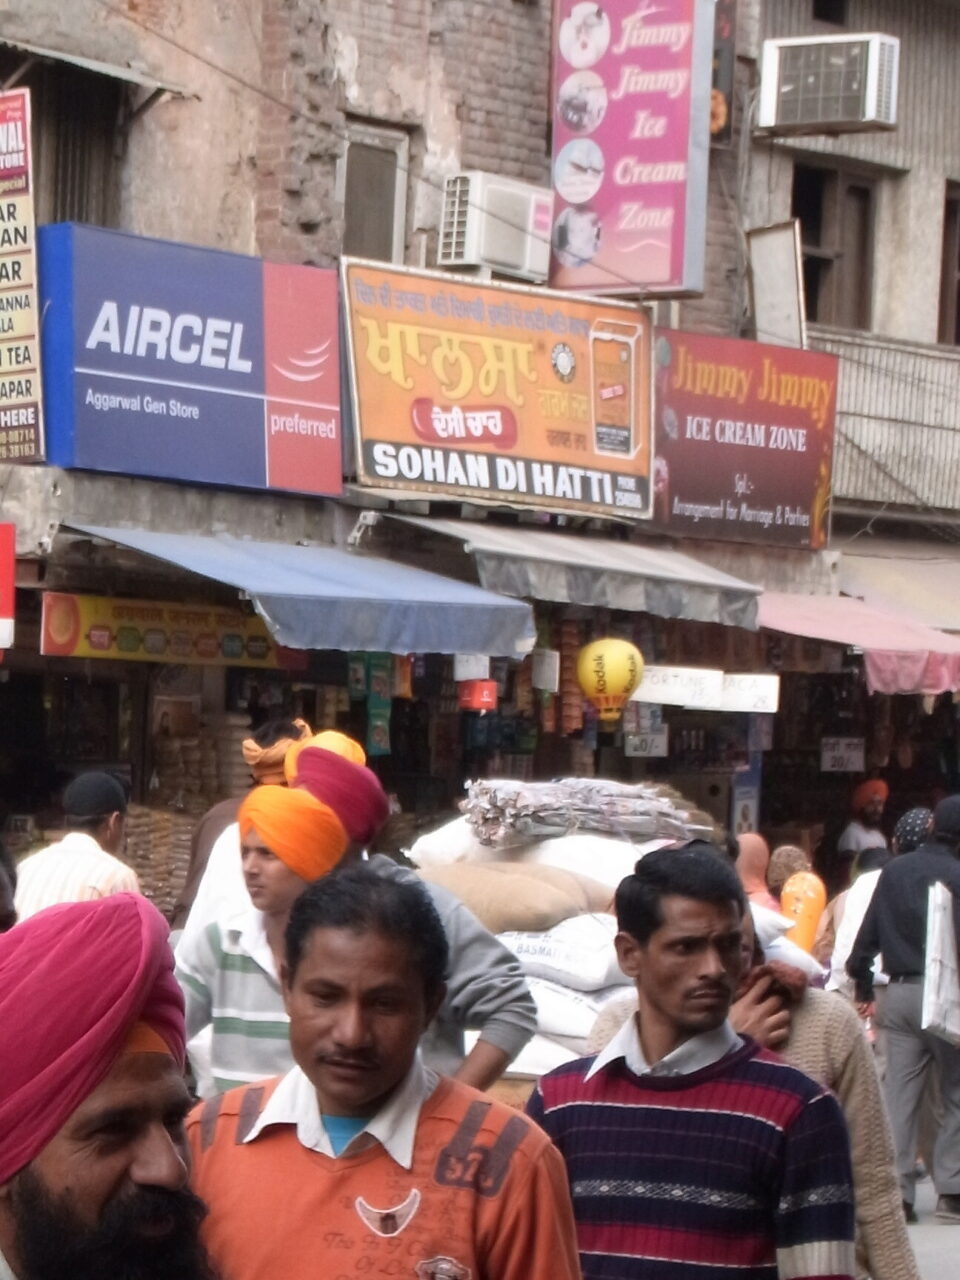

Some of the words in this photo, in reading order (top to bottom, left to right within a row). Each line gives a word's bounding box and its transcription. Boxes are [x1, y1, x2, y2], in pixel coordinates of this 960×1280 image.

[612, 18, 692, 54] Jimmy
[611, 64, 689, 99] Jimmy
[629, 110, 667, 139] Ice
[613, 155, 687, 186] Cream
[617, 201, 674, 232] Zone
[85, 301, 252, 373] AIRCEL
[7, 345, 32, 366] TEA
[85, 388, 141, 412] Aggarwal
[143, 396, 166, 415] Gen
[169, 398, 200, 420] Store
[672, 345, 752, 405] Jimmy
[758, 357, 833, 430] Jimmy
[0, 407, 35, 427] HERE
[270, 413, 336, 439] preferred
[685, 416, 712, 441] ICE
[715, 419, 765, 448] CREAM
[768, 426, 807, 452] ZONE
[372, 443, 490, 489] SOHAN
[496, 457, 527, 493] DI
[531, 461, 614, 505] HATTI
[672, 496, 724, 522] Arrangement
[726, 500, 738, 520] for
[593, 654, 606, 694] Kodak
[624, 654, 638, 693] Kodak
